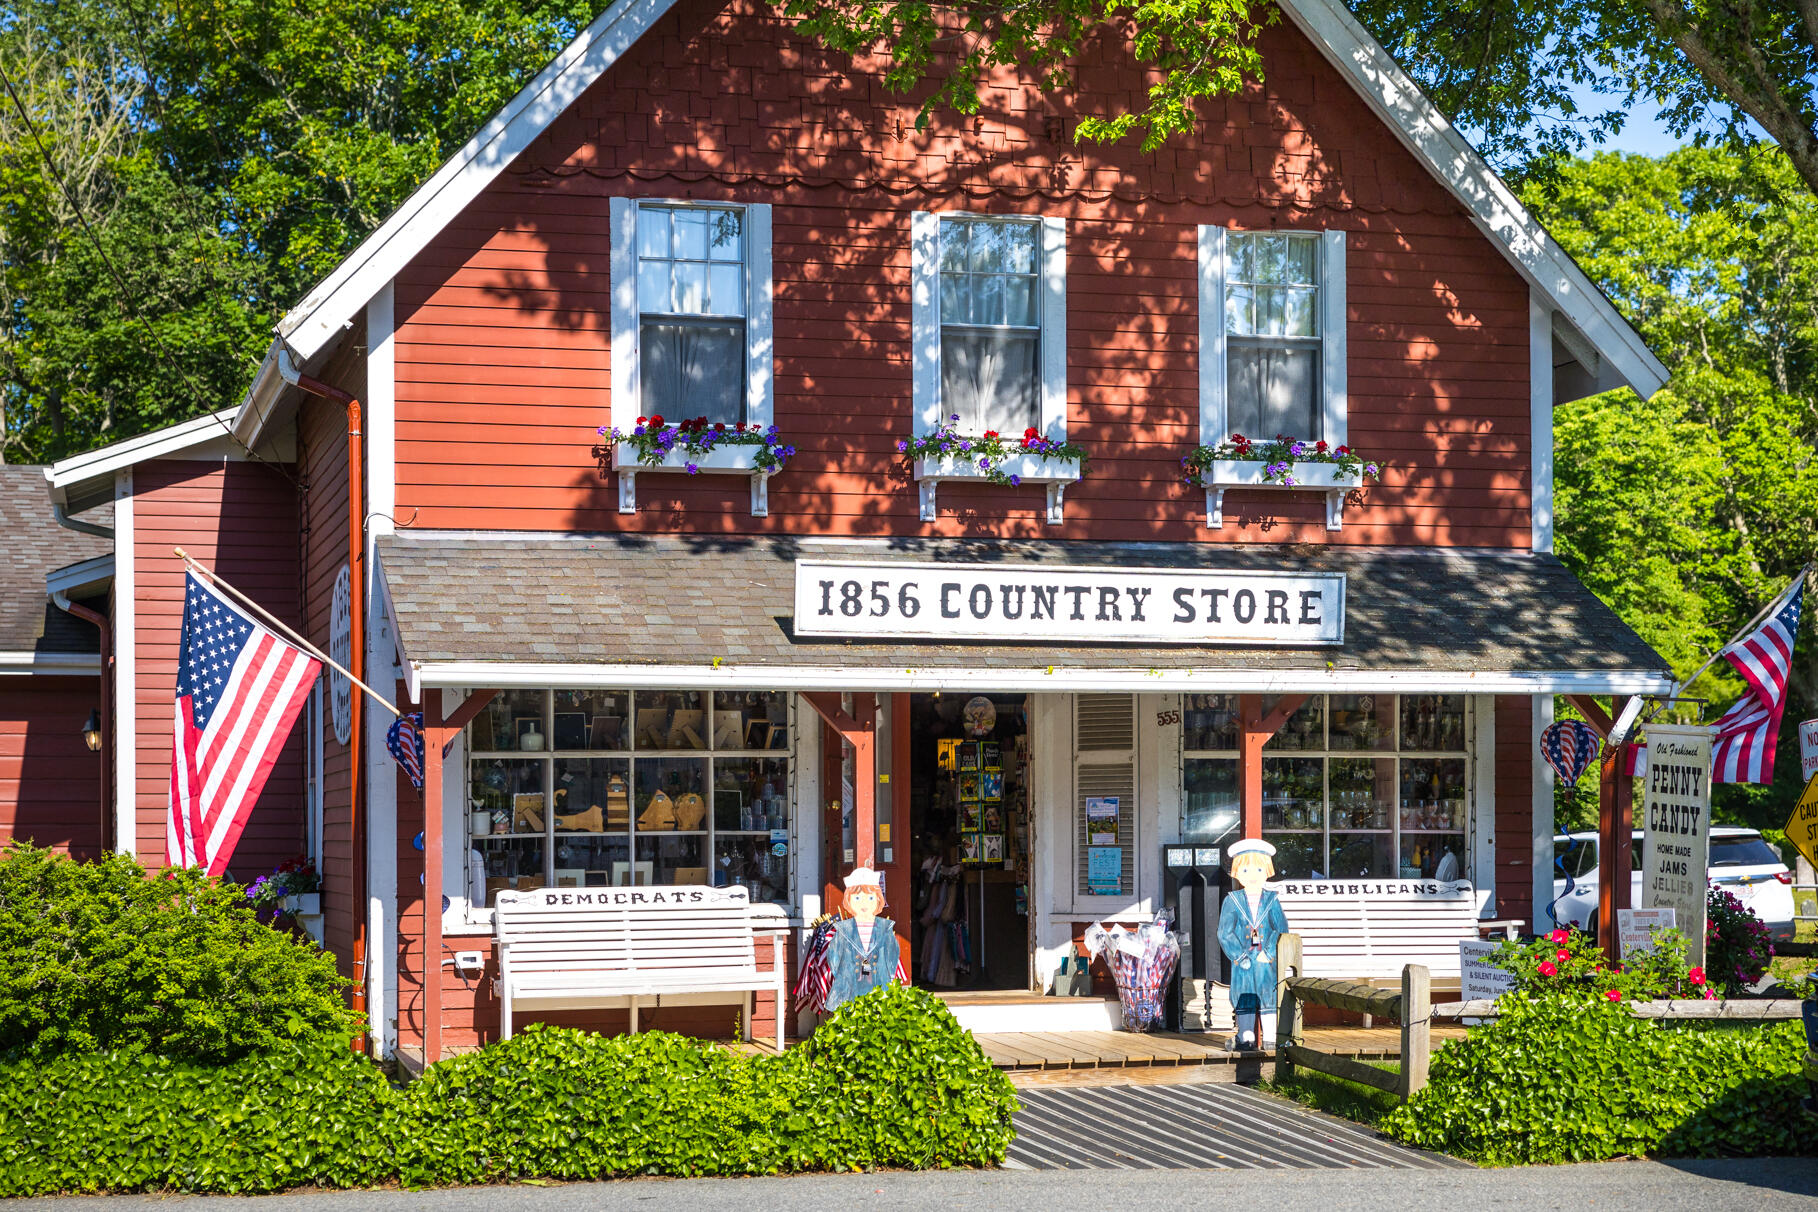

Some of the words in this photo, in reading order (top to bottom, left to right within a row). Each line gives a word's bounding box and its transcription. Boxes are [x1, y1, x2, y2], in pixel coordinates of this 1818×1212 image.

[818, 580, 921, 617] 1856
[940, 582, 1151, 622] COUNTRY
[1173, 587, 1322, 625] STORE
[1157, 711, 1179, 726] 555
[1656, 742, 1667, 754] Old
[1669, 743, 1699, 757] Fashioned
[1804, 758, 1818, 770] PARK
[1652, 764, 1702, 796] PENNY
[1800, 804, 1818, 820] CAU
[1651, 802, 1700, 836] CANDY
[1657, 844, 1673, 855] HOME
[1675, 846, 1691, 857] MADE
[1660, 860, 1687, 876] JAMS
[1286, 884, 1438, 895] REPUBLICANS
[545, 892, 704, 905] DEMOCRATS
[1621, 932, 1651, 942] Centervill
[1463, 946, 1494, 957] Centervill
[1474, 972, 1492, 981] SILENT
[1468, 983, 1492, 995] Saturday,
